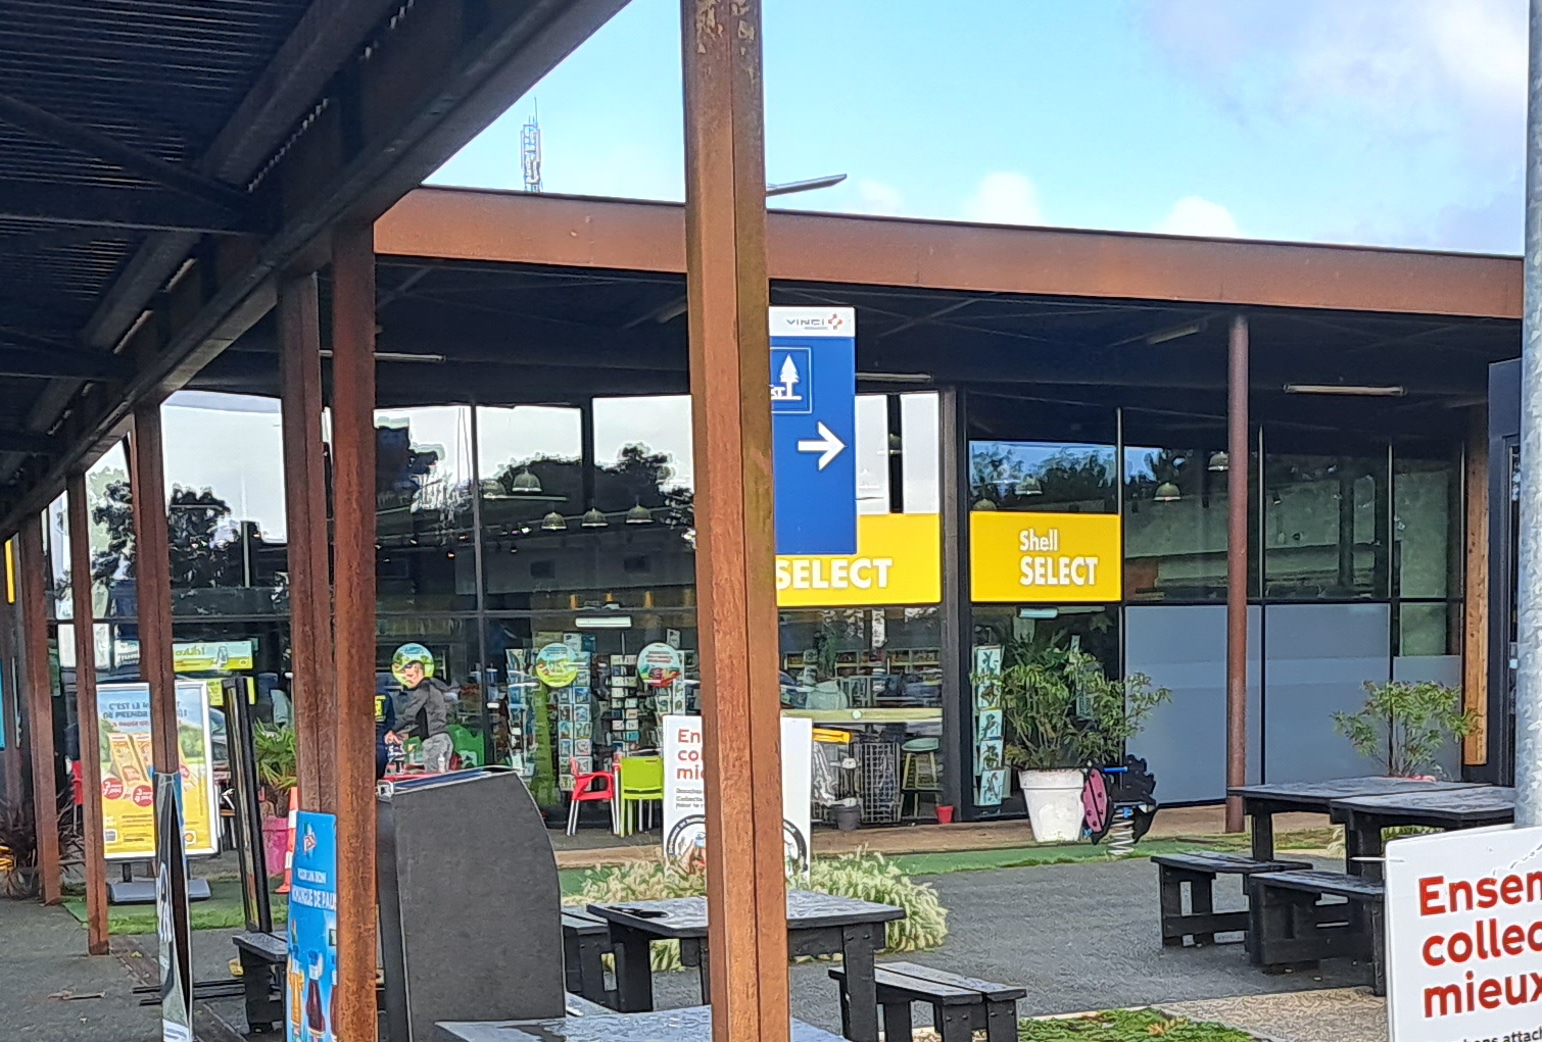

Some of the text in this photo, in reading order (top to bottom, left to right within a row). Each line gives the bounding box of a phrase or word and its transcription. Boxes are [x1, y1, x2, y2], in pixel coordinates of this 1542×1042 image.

[786, 318, 825, 326] VINCI
[1019, 528, 1059, 552] Shell
[775, 557, 893, 590] SELECT
[1019, 556, 1099, 586] SELECT
